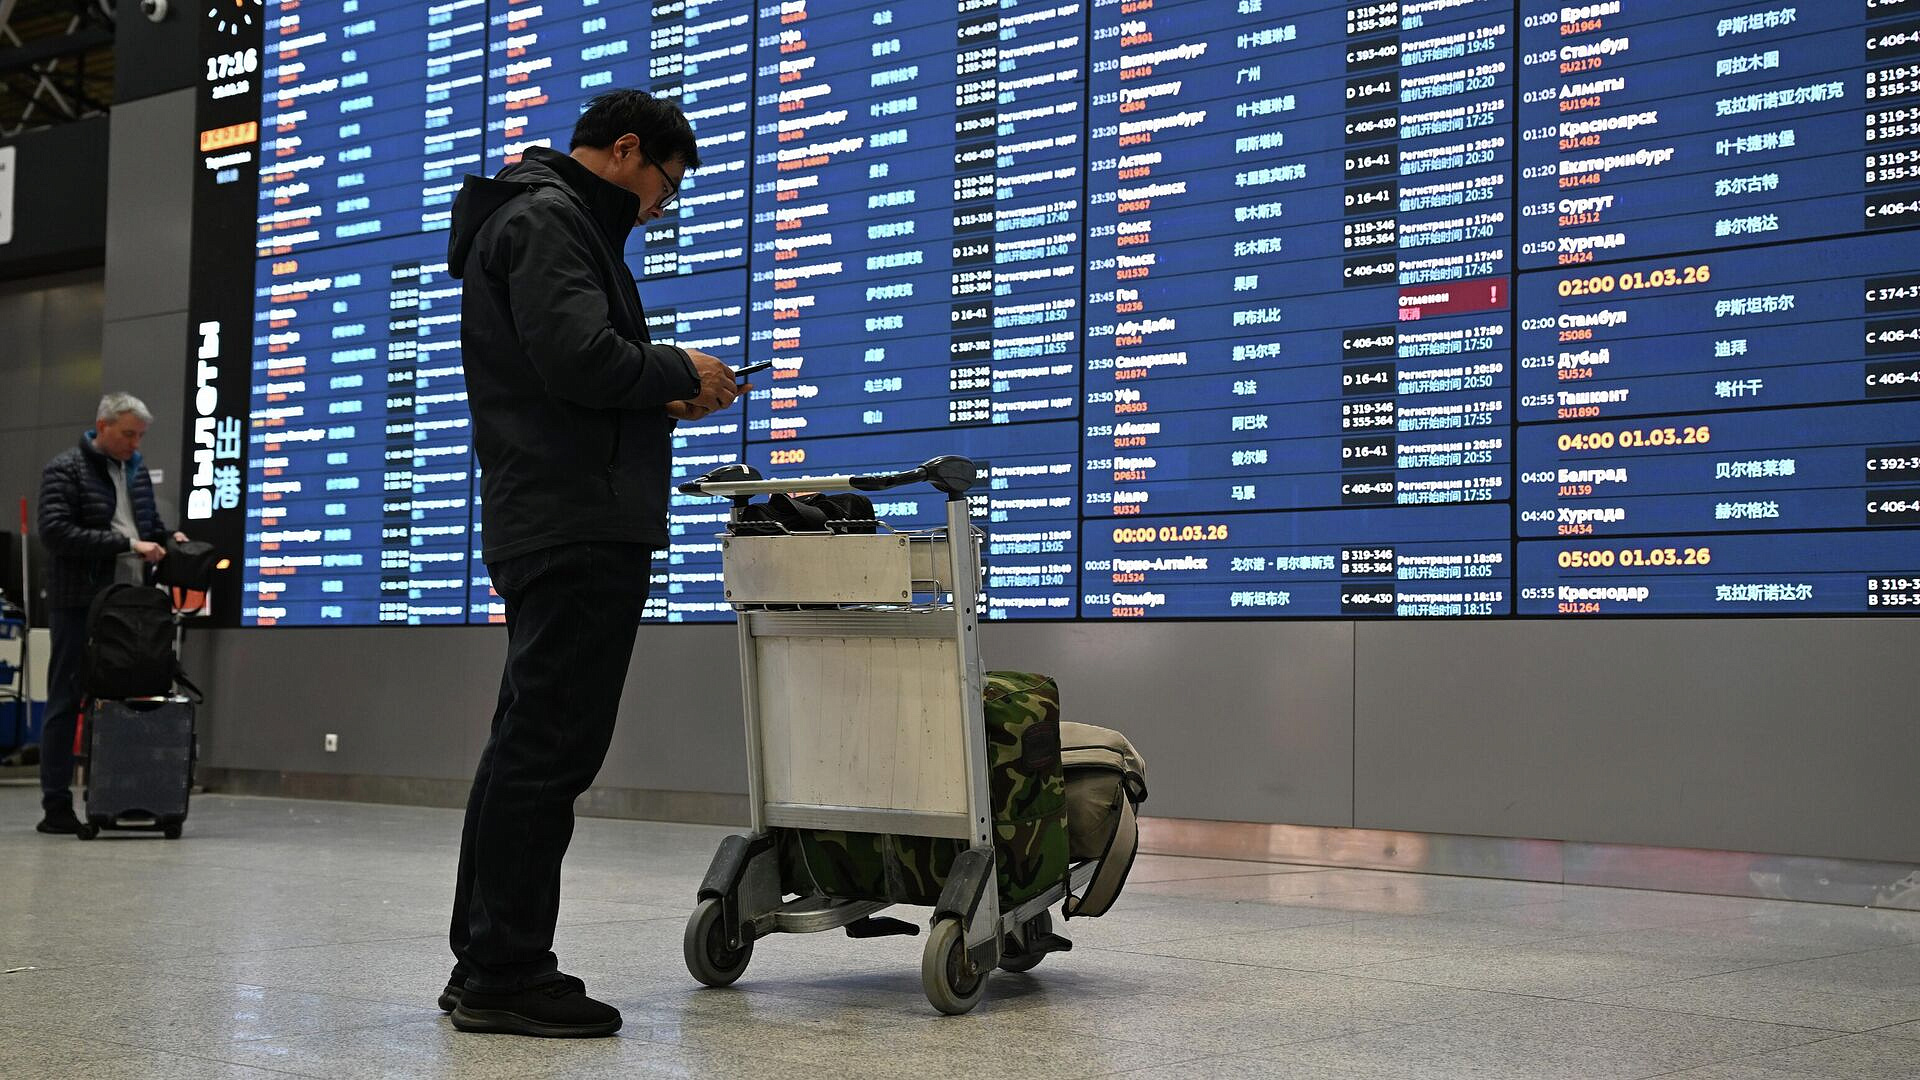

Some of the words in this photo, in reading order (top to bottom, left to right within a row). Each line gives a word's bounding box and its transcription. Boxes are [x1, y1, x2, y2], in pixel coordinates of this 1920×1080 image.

[1524, 12, 1558, 28] 01:00
[1560, 1, 1620, 24] Ереван
[1094, 26, 1120, 40] 23:10
[1560, 19, 1602, 36] SU1964
[1467, 38, 1495, 53] 19:45
[1866, 38, 1876, 49] C
[1880, 31, 1920, 47] 406-4
[1524, 50, 1557, 66] 01:05
[1560, 35, 1629, 61] Стамбул
[207, 48, 257, 81] 17:16
[1093, 59, 1118, 73] 23:10
[1559, 58, 1602, 74] SU2170
[1866, 72, 1876, 84] B
[1880, 65, 1920, 82] 319-3
[1347, 88, 1356, 99] D
[1359, 82, 1391, 97] 16-41
[1523, 87, 1556, 104] 01:05
[1559, 76, 1625, 99] Алматы
[1559, 96, 1600, 112] SU1942
[1092, 126, 1117, 139] 23:20
[1523, 126, 1556, 141] 01:10
[1559, 110, 1658, 138] Красноярск
[1559, 135, 1600, 151] SU1482
[1091, 158, 1116, 171] 23:25
[1522, 164, 1556, 179] 01:20
[1559, 147, 1674, 176] Екатеринбург
[1559, 173, 1600, 189] SU1448
[1522, 201, 1555, 217] 01:35
[1558, 194, 1614, 214] Сургут
[1558, 211, 1599, 227] SU1512
[1090, 225, 1115, 237] 23:35
[1522, 240, 1555, 255] 01:50
[1558, 231, 1625, 253] Хургада
[953, 247, 961, 258] D
[963, 244, 988, 257] 12-14
[1558, 251, 1593, 265] SU424
[1090, 259, 1115, 270] 23:40
[1558, 276, 1615, 297] 02:00
[1619, 266, 1710, 292] 01.03.26
[1089, 291, 1114, 303] 23:45
[1866, 290, 1876, 301] C
[952, 311, 959, 321] D
[961, 308, 987, 320] 16-41
[1521, 316, 1555, 331] 02:00
[1558, 310, 1627, 330] Стамбул
[1089, 325, 1114, 336] 23:50
[1398, 330, 1463, 344] Регистрация
[1473, 325, 1503, 336] 17:50
[1558, 329, 1593, 342] 2S086
[1866, 332, 1876, 343] C
[1879, 329, 1920, 342] 406-4
[1715, 339, 1747, 358] 迪拜
[1088, 359, 1113, 370] 23:50
[1521, 354, 1555, 369] 02:15
[1557, 349, 1610, 371] Дубай
[1558, 367, 1593, 381] SU524
[1715, 378, 1763, 398] 塔什干
[1088, 392, 1113, 403] 23:50
[1521, 393, 1555, 408] 02:55
[1557, 387, 1628, 406] Ташкент
[1557, 405, 1599, 419] SU1890
[1087, 426, 1112, 437] 23:55
[1557, 431, 1615, 452] 04:00
[1619, 426, 1710, 448] 01.03.26
[213, 416, 241, 510] 出港
[770, 449, 805, 464] 22:00
[1867, 459, 1877, 470] C
[1880, 457, 1920, 470] 392-3
[1087, 459, 1112, 470] 23:55
[1521, 471, 1555, 484] 04:00
[1558, 467, 1627, 484] Белград
[1342, 485, 1350, 494] C
[1352, 483, 1393, 494] 406-430
[1463, 489, 1492, 501] 17:55
[1558, 485, 1592, 497] JU139
[1086, 493, 1111, 503] 23:55
[1521, 510, 1555, 523] 04:40
[1557, 506, 1625, 524] Хургада
[1113, 528, 1156, 543] 00:00
[1159, 525, 1228, 542] 01.03.26
[1558, 524, 1593, 536] SU434
[1041, 542, 1063, 552] 19:05
[1342, 551, 1350, 560] B
[1352, 550, 1393, 560] 319-346
[1557, 550, 1615, 569] 05:00
[1619, 548, 1711, 567] 01.03.26
[1085, 561, 1111, 571] 00:05
[1342, 564, 1350, 573] B
[1352, 563, 1393, 573] 355-364
[1868, 579, 1878, 590] B
[1084, 594, 1110, 605] 00:15
[1342, 594, 1350, 603] C
[1351, 594, 1393, 604] 406-430
[1397, 593, 1462, 604] Регистрация
[1521, 587, 1555, 600] 05:35
[1558, 586, 1649, 602] Краснодар
[1868, 594, 1878, 605] B
[1463, 603, 1492, 615] 18:15
[1558, 602, 1600, 614] SU1264
